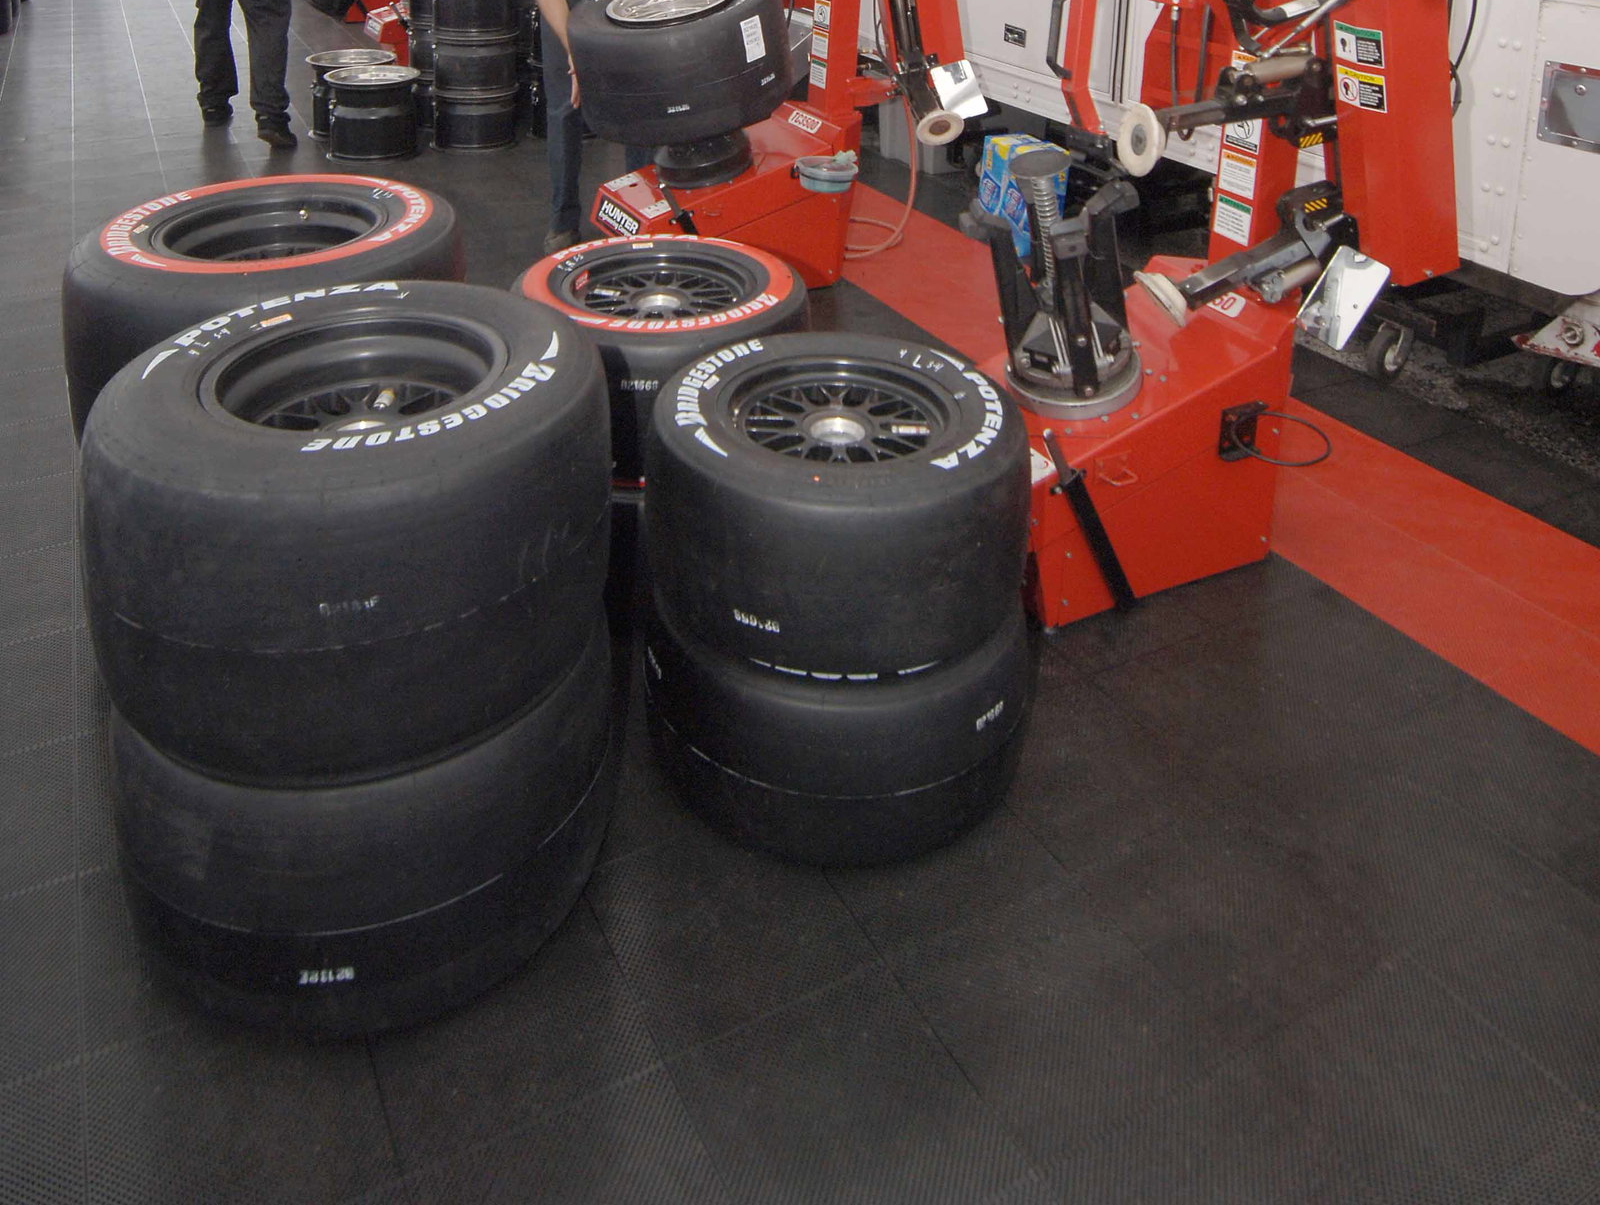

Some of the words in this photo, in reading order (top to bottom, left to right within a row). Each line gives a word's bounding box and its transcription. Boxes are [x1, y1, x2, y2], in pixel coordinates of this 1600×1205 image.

[106, 191, 192, 256] BRIDGESTONE
[368, 185, 426, 242] POTENZA
[601, 200, 639, 235] HUNTER
[552, 234, 698, 260] POTENZA
[174, 282, 399, 347] POTENZA
[608, 292, 780, 330] BRIDGESTONE
[301, 362, 556, 452] BRIDGESTONE
[675, 338, 764, 427] BRIDGESTONE
[930, 371, 1003, 470] POTENZA
